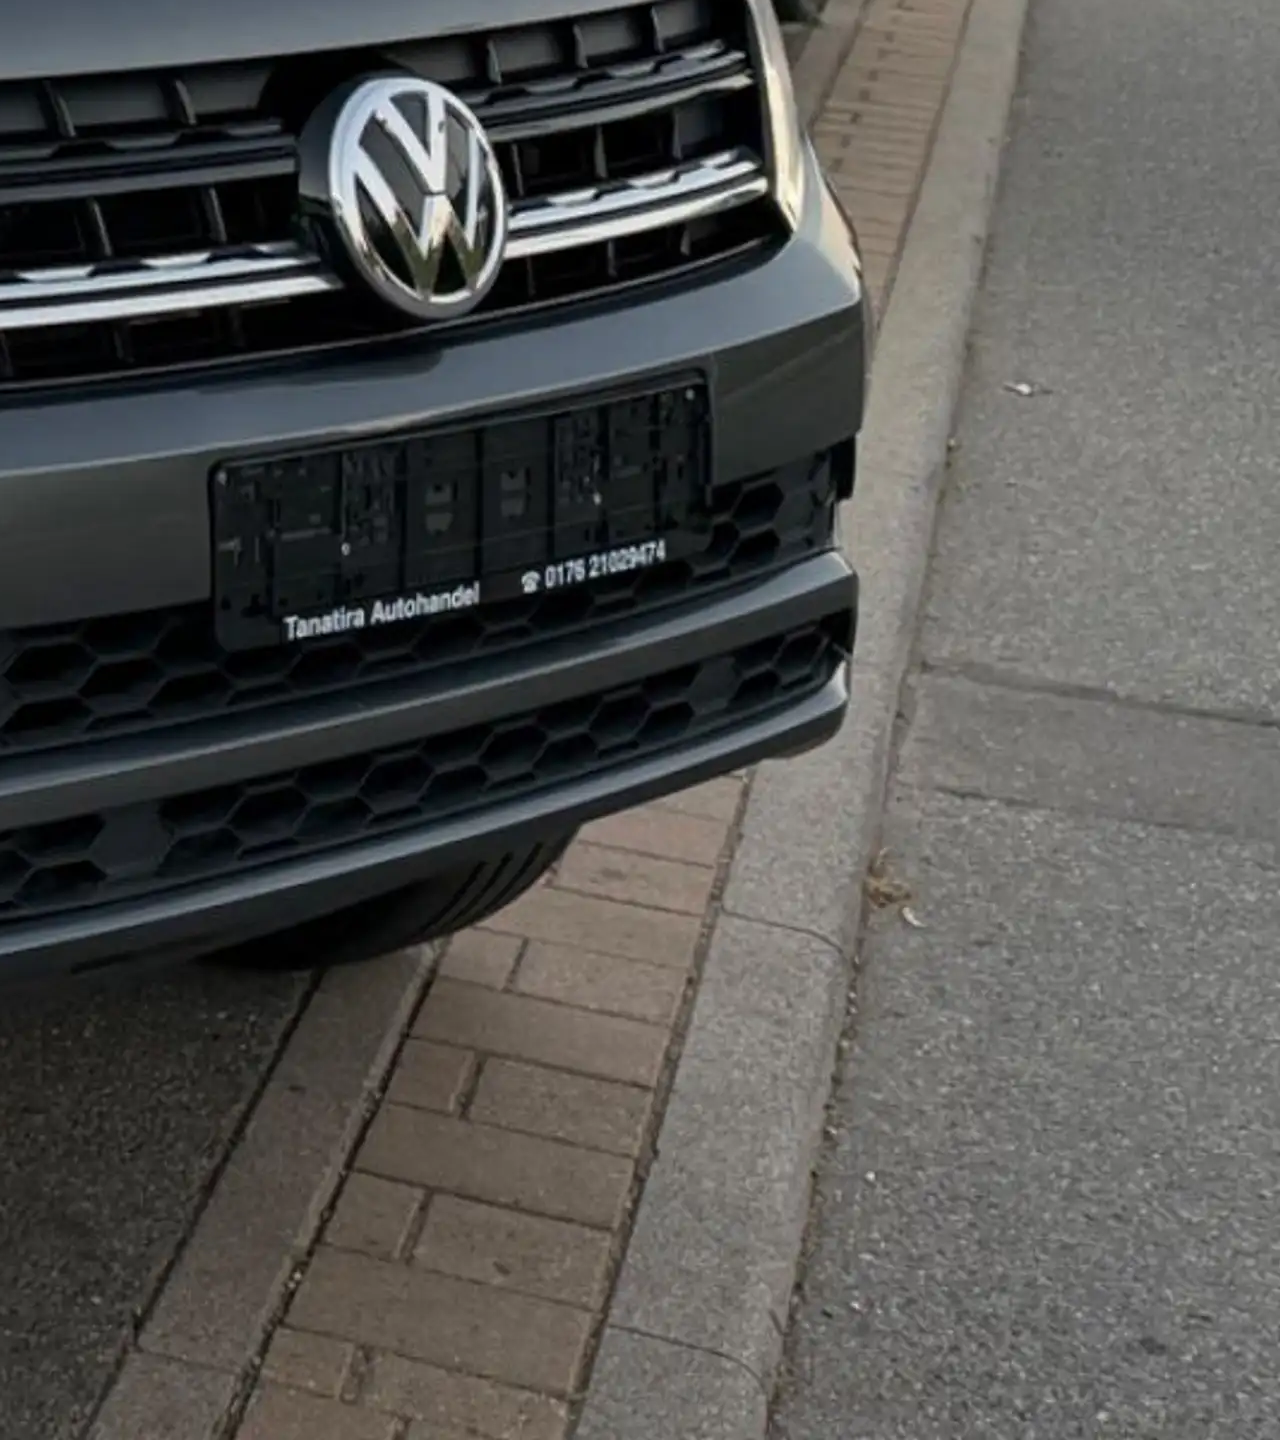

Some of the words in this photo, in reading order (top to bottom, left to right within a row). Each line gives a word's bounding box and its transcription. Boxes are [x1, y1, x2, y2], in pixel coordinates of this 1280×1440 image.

[282, 607, 366, 642] Tanatira
[369, 580, 481, 626] Autohandel
[544, 557, 586, 590] 0176
